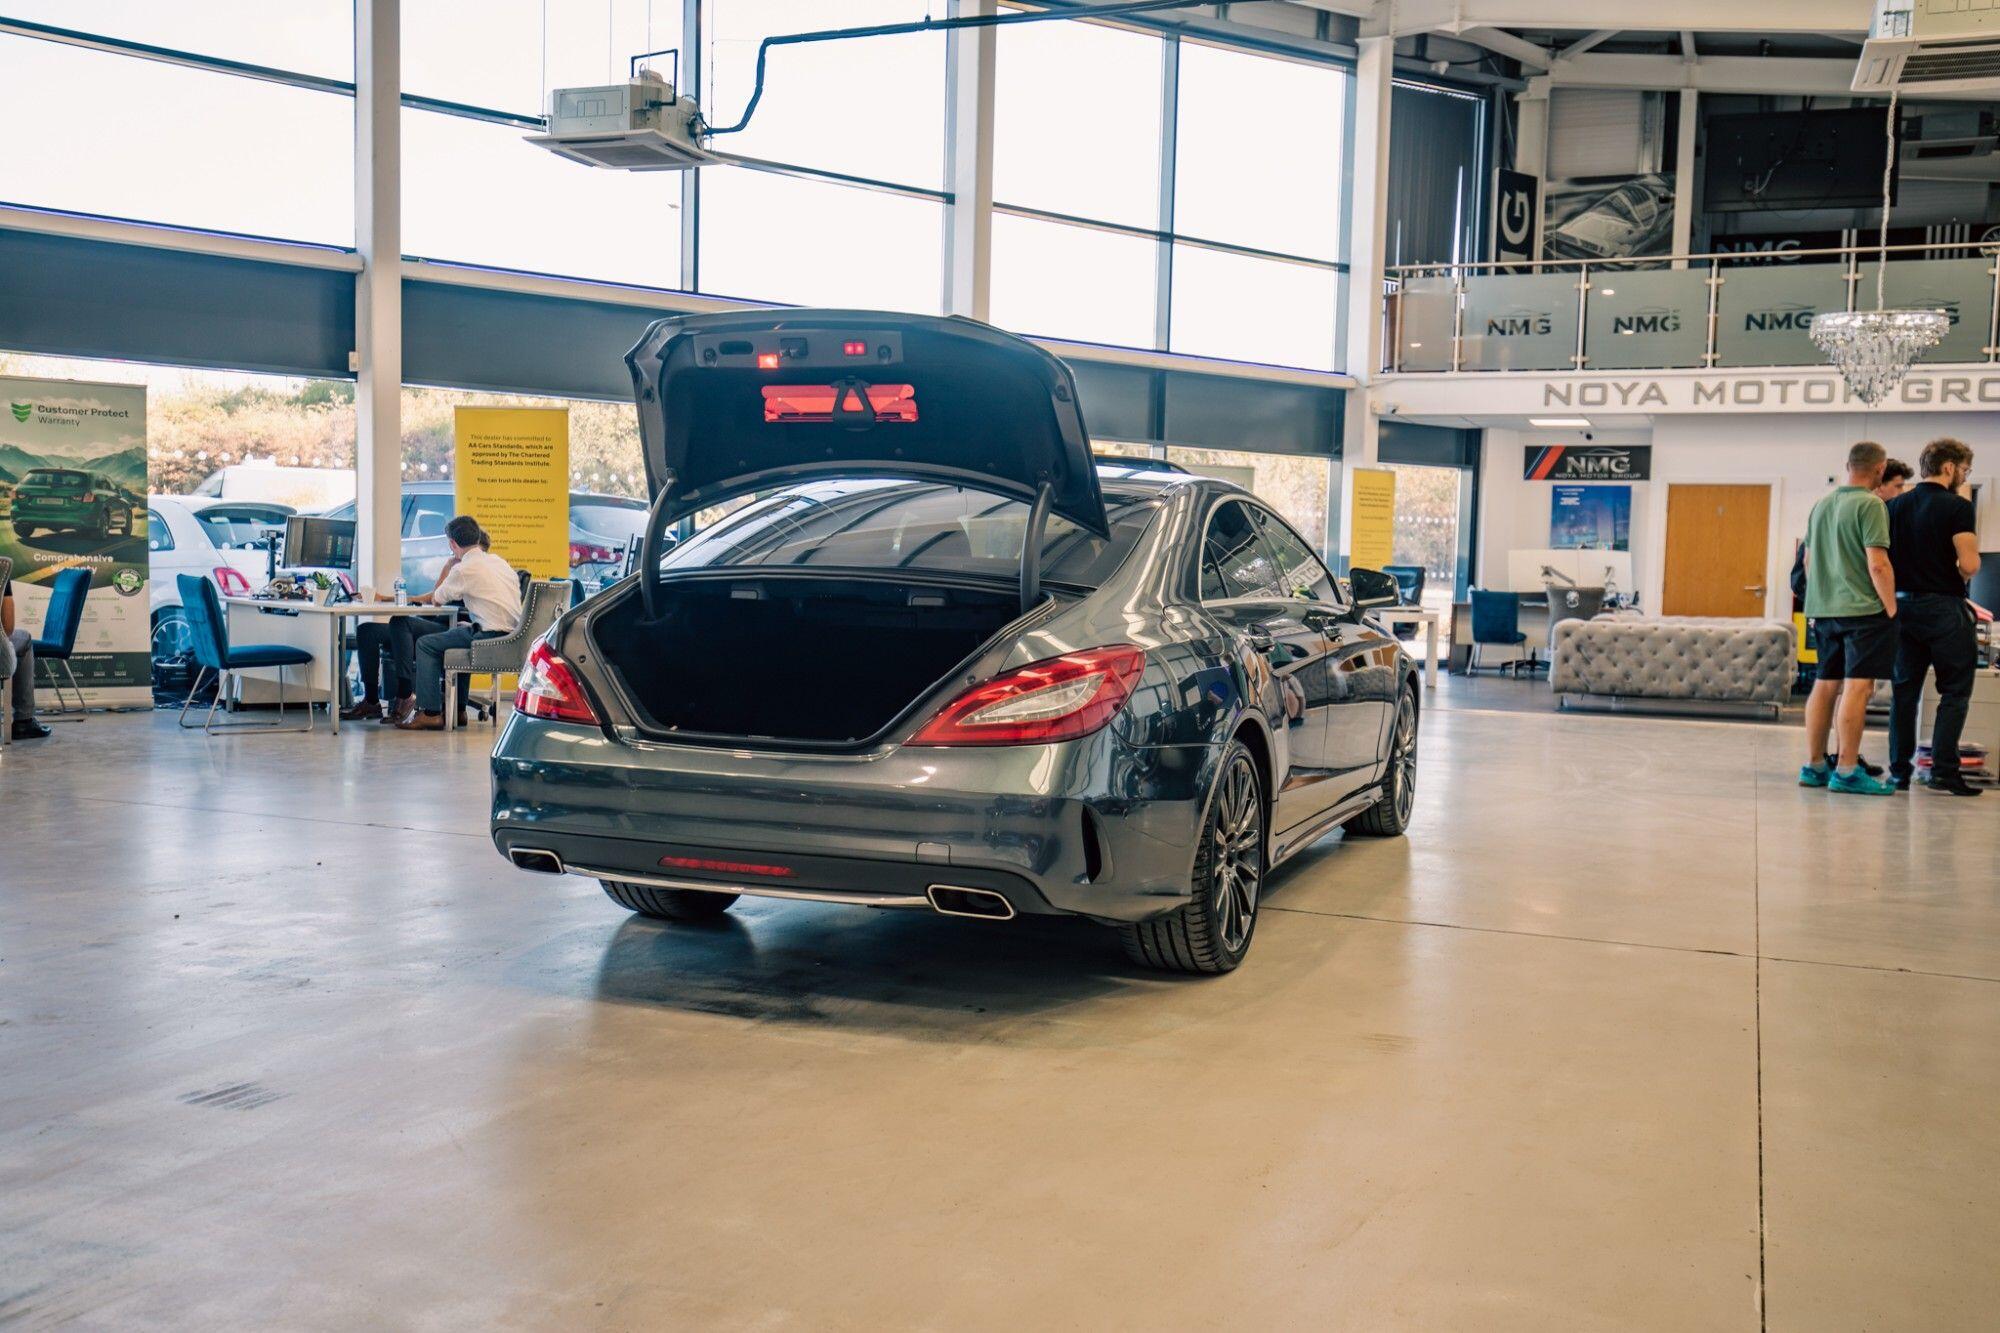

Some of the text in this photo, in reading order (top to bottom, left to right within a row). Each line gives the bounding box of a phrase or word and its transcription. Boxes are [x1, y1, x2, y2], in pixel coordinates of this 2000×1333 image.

[1487, 318, 1552, 336] NMG
[1613, 315, 1681, 334] NMG
[1744, 312, 1815, 331] NMG
[1544, 381, 1668, 406] NOYA
[38, 404, 129, 418] Customer Protect
[38, 415, 80, 427] Warranty
[1566, 456, 1631, 473] NMG
[33, 553, 114, 564] Comprehensive
